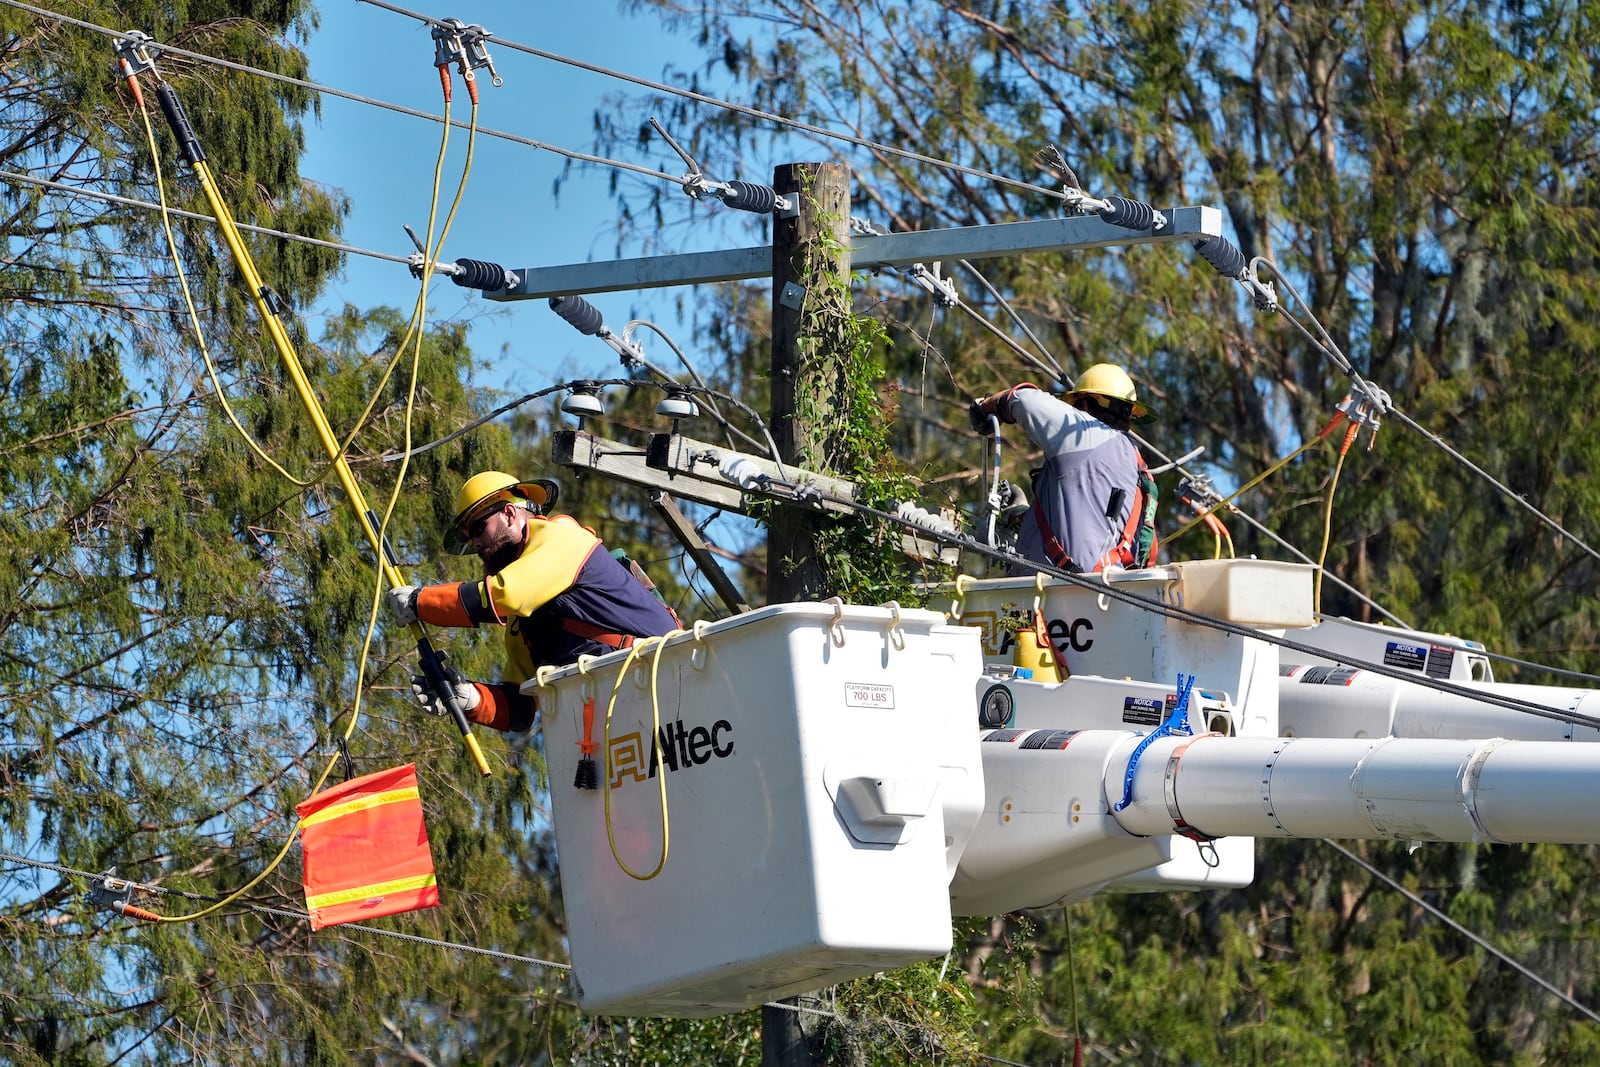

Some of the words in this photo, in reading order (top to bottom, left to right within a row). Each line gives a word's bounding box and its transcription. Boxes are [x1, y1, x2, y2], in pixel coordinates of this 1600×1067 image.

[1396, 643, 1417, 653] NOTICE
[853, 691, 868, 700] 700
[871, 692, 887, 701] LBS
[1133, 697, 1154, 707] NOTICE
[647, 719, 735, 779] Altec
